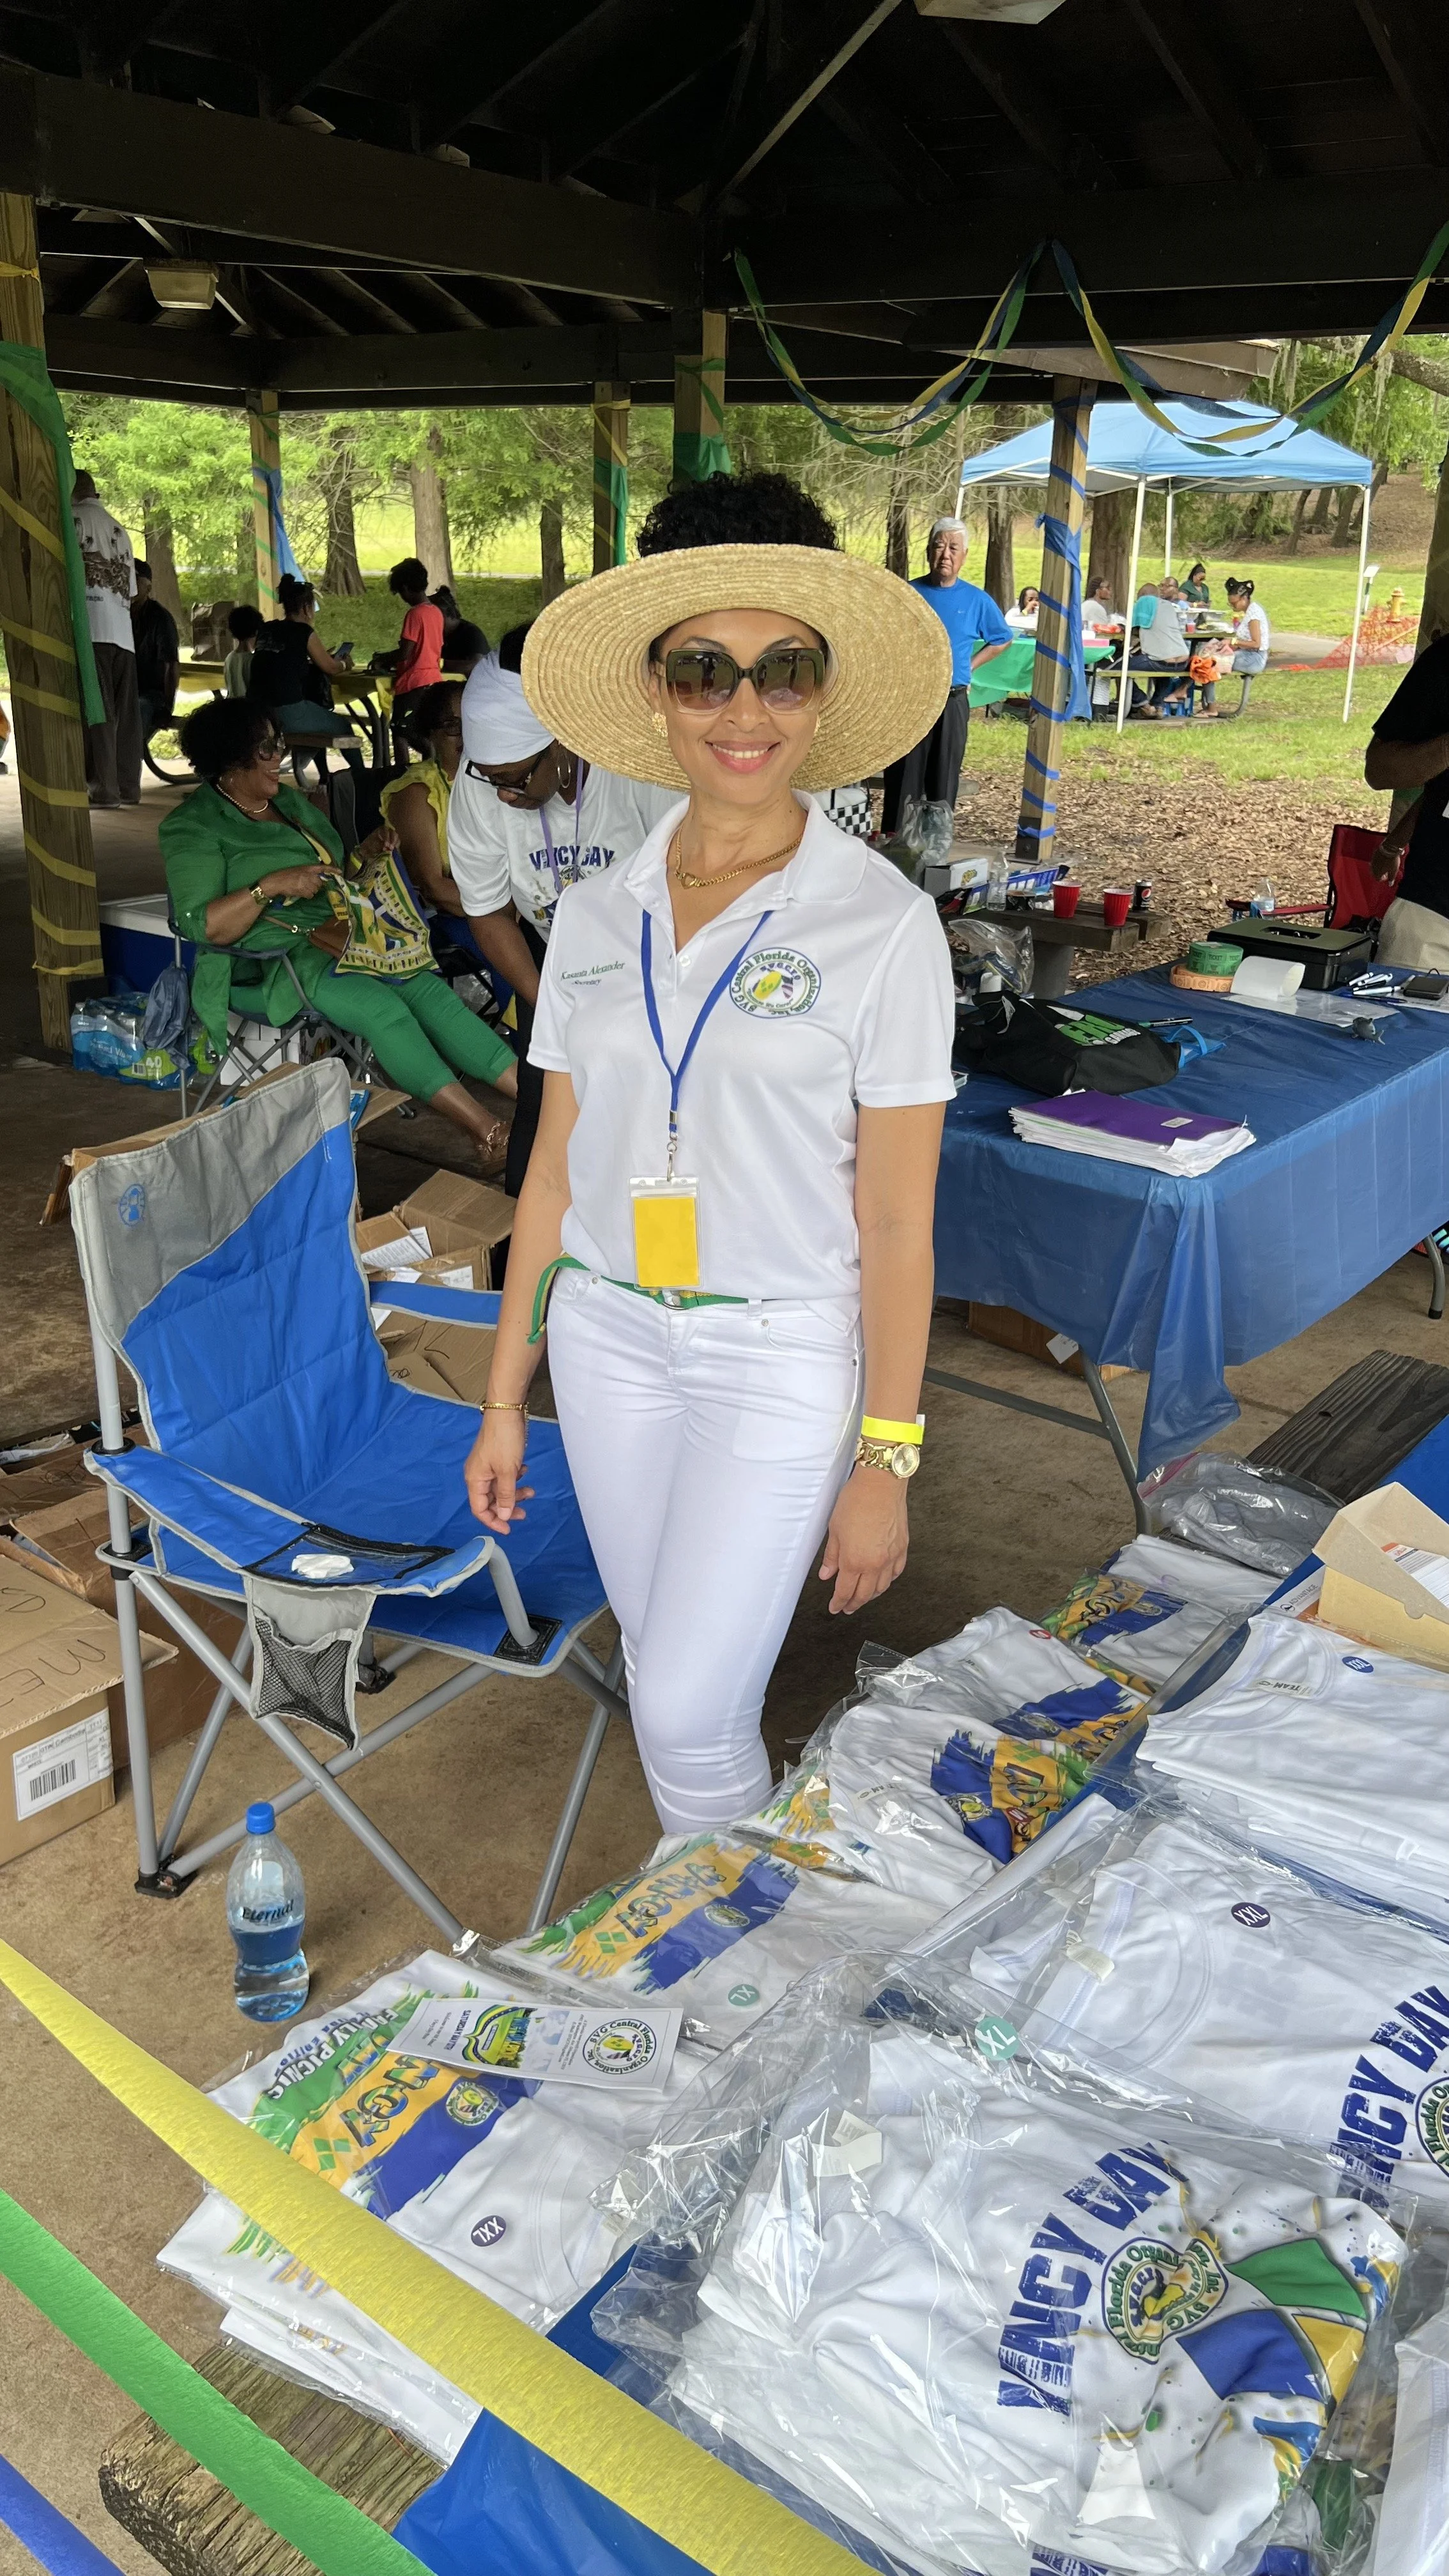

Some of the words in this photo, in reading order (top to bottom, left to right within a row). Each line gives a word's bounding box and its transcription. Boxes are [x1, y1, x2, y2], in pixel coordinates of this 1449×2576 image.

[752, 951, 795, 964] Florida
[145, 1055, 163, 1068] 40
[1346, 1658, 1370, 1670] XXXL
[242, 1898, 294, 1921] Eternal
[1234, 1905, 1269, 1926] XXL
[731, 1985, 756, 2002] XL
[331, 2008, 399, 2047] FAMILY
[610, 2020, 643, 2030] Central
[641, 2023, 654, 2055] Florida
[975, 2022, 1016, 2055] XL
[267, 2041, 336, 2099] PICNIC
[339, 2055, 440, 2148] NCY
[1420, 2097, 1445, 2153] Florida
[472, 2217, 503, 2242] XXL
[996, 2212, 1108, 2417] VINCY
[1062, 2142, 1189, 2230] DAY
[1106, 2260, 1133, 2329] Florida
